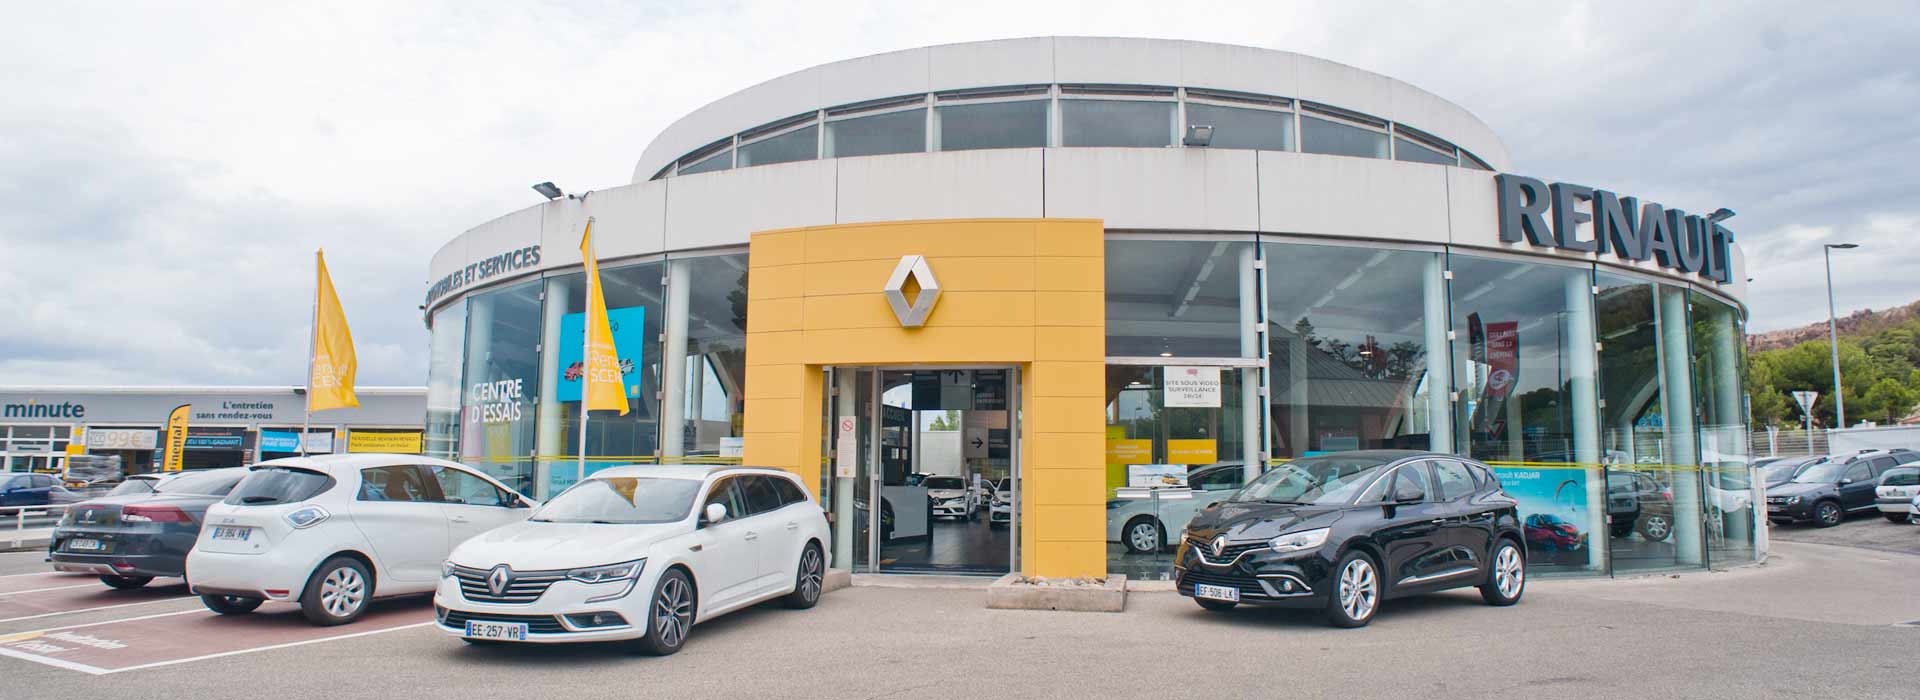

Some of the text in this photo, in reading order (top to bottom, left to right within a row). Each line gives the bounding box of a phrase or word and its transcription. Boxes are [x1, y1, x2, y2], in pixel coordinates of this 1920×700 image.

[1493, 172, 1735, 285] RENAULT
[464, 262, 478, 285] ET
[479, 245, 541, 279] SERVICES
[472, 378, 523, 401] CENTRE
[4, 399, 85, 418] minute
[217, 410, 273, 419] rendez-vous
[222, 401, 274, 410] L'entretien
[472, 401, 521, 423] D'ESSAIS
[1513, 471, 1540, 480] KADJAR
[472, 623, 519, 638] EE-257-VR
